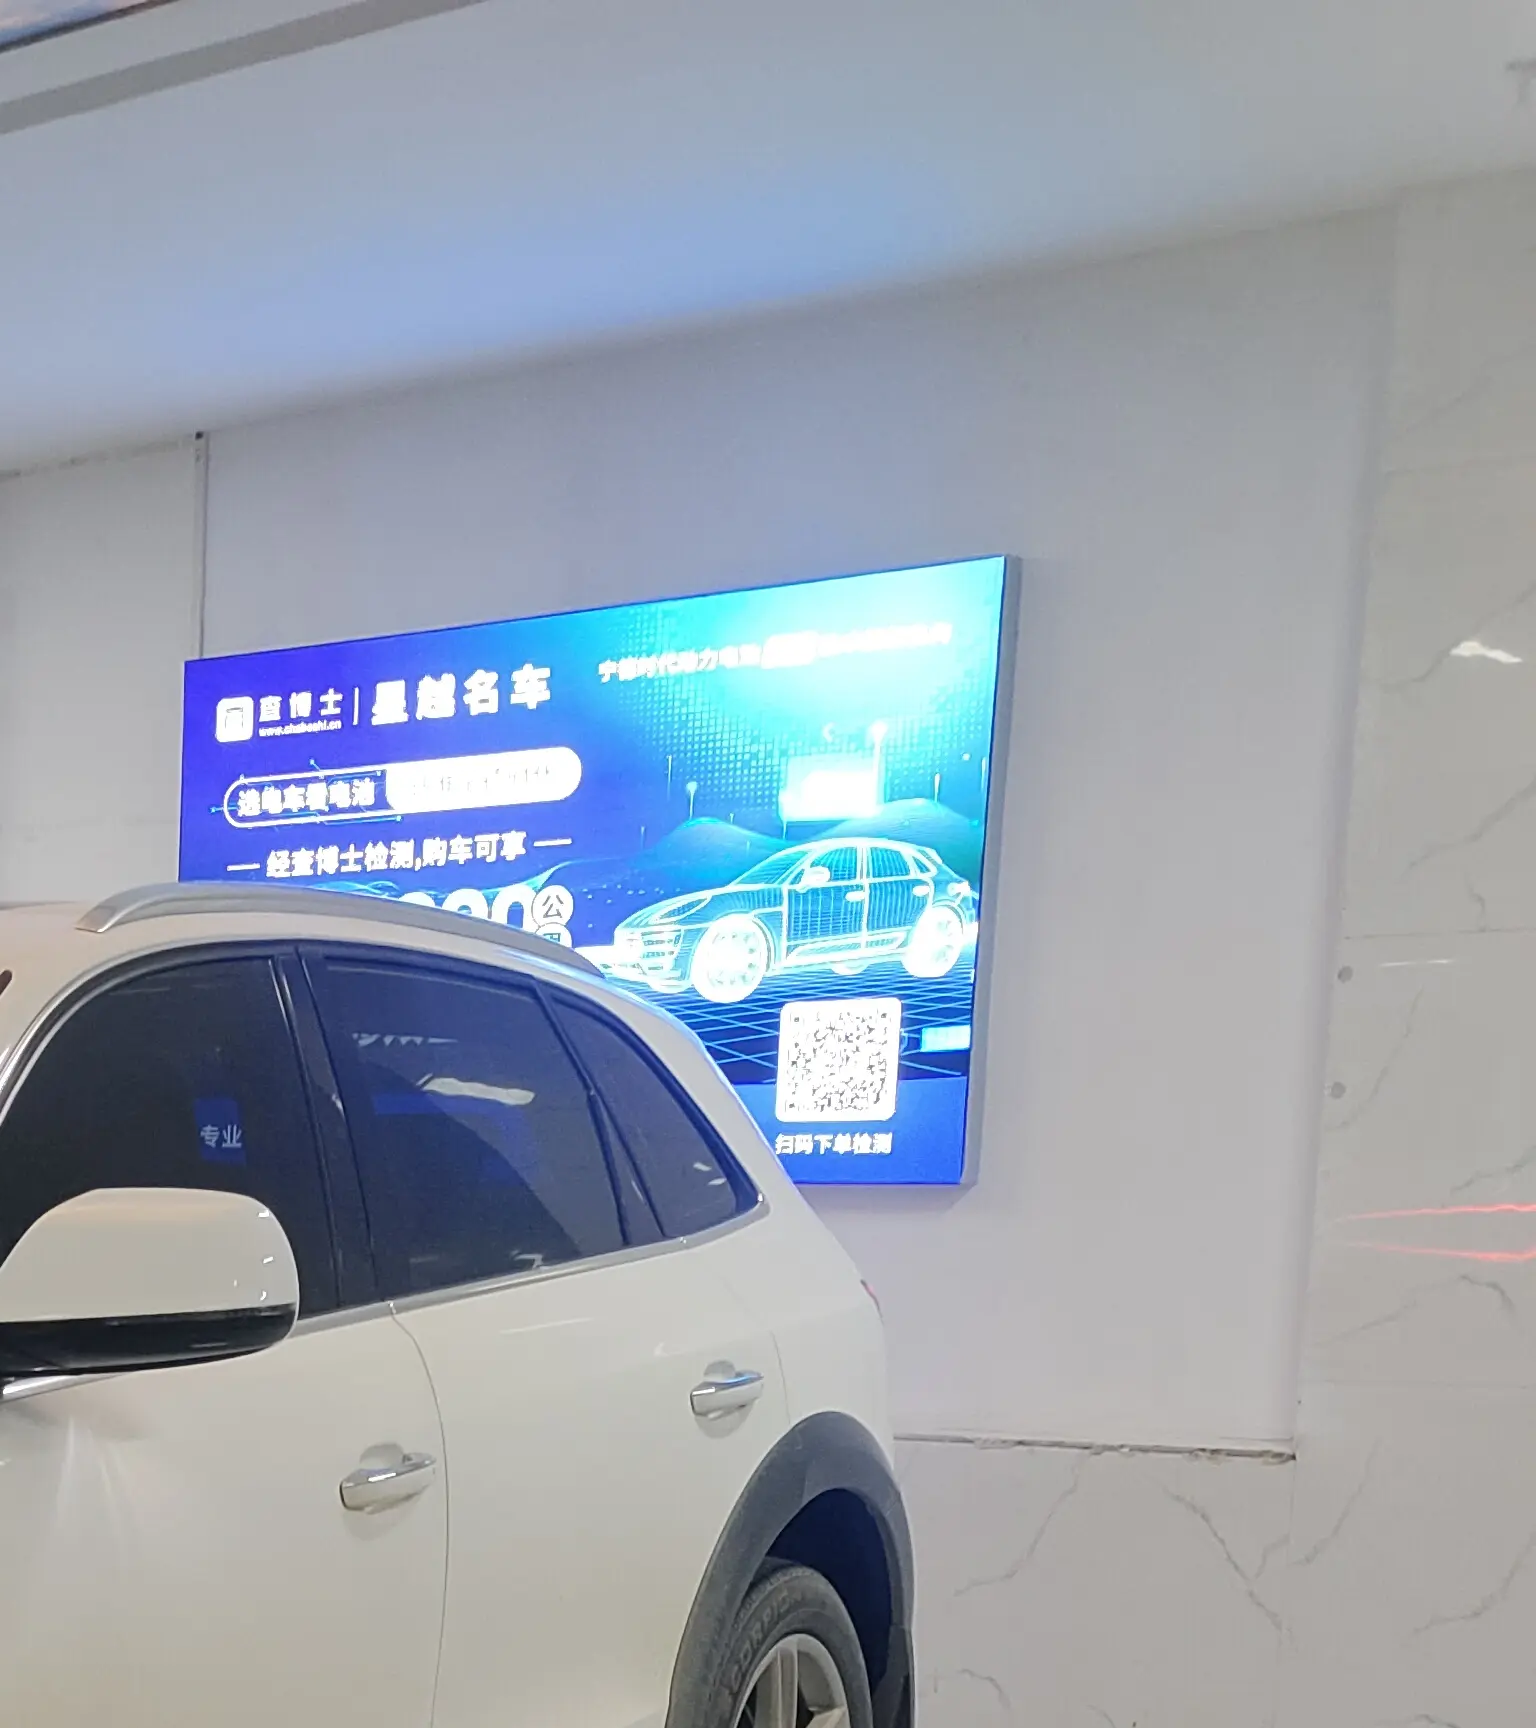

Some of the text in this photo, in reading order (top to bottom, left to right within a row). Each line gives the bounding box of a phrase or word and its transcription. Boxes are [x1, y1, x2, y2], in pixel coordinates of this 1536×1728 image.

[371, 663, 551, 726] 星越名车
[200, 1124, 243, 1149] 专业
